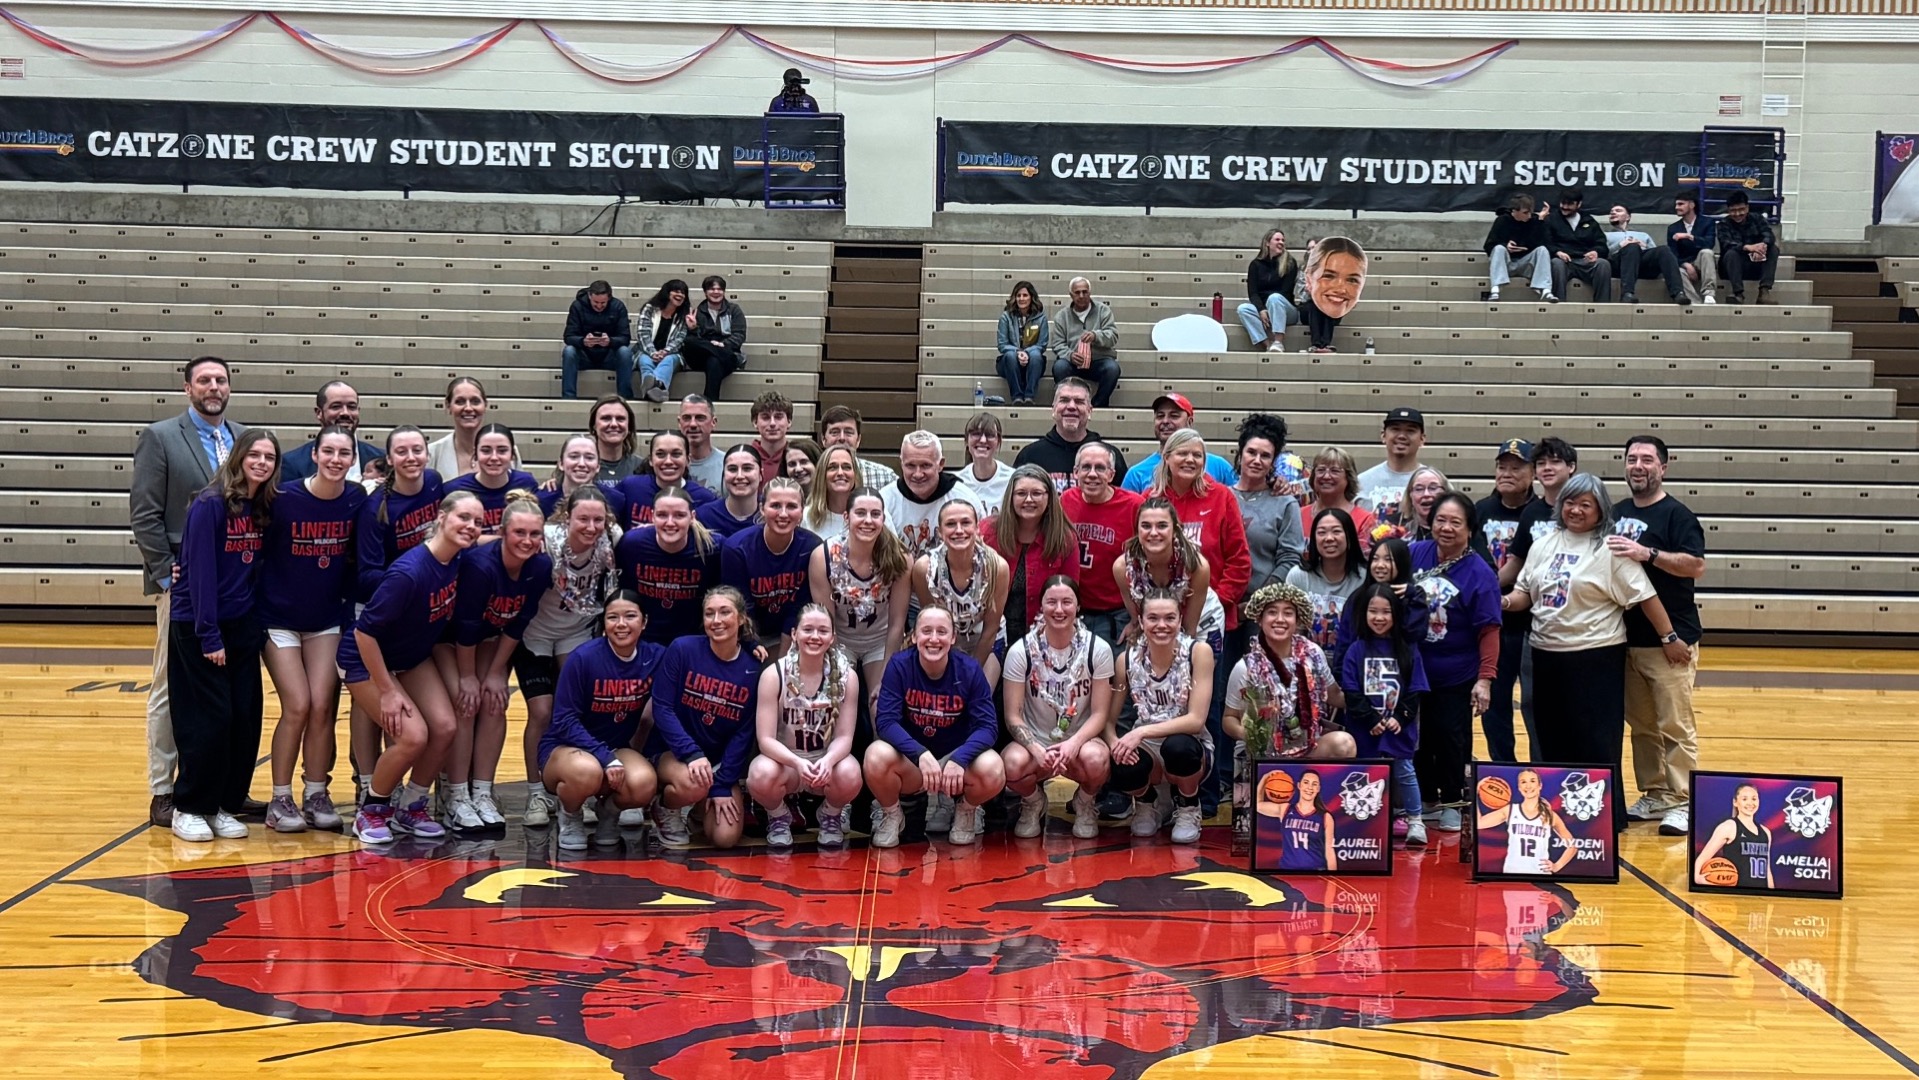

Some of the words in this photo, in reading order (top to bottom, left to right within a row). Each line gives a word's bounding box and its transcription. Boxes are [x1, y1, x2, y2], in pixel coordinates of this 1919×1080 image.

[267, 135, 377, 163] CREW
[390, 139, 556, 168] STUDENT
[1222, 155, 1328, 183] CREW
[1340, 157, 1501, 186] STUDENT
[636, 563, 701, 584] LINFIELD
[684, 671, 749, 703] LINFIELD
[1285, 818, 1320, 833] LINFIELD
[1292, 831, 1309, 850] 14
[1331, 838, 1378, 848] LAUREL
[1520, 838, 1537, 857] 12
[1552, 837, 1601, 849] JAYDEN
[1337, 849, 1379, 861] QUINN
[1577, 849, 1603, 861] RAY
[1776, 854, 1828, 868] AMELIA
[1750, 857, 1767, 879] 10
[1794, 867, 1829, 880] SOLT
